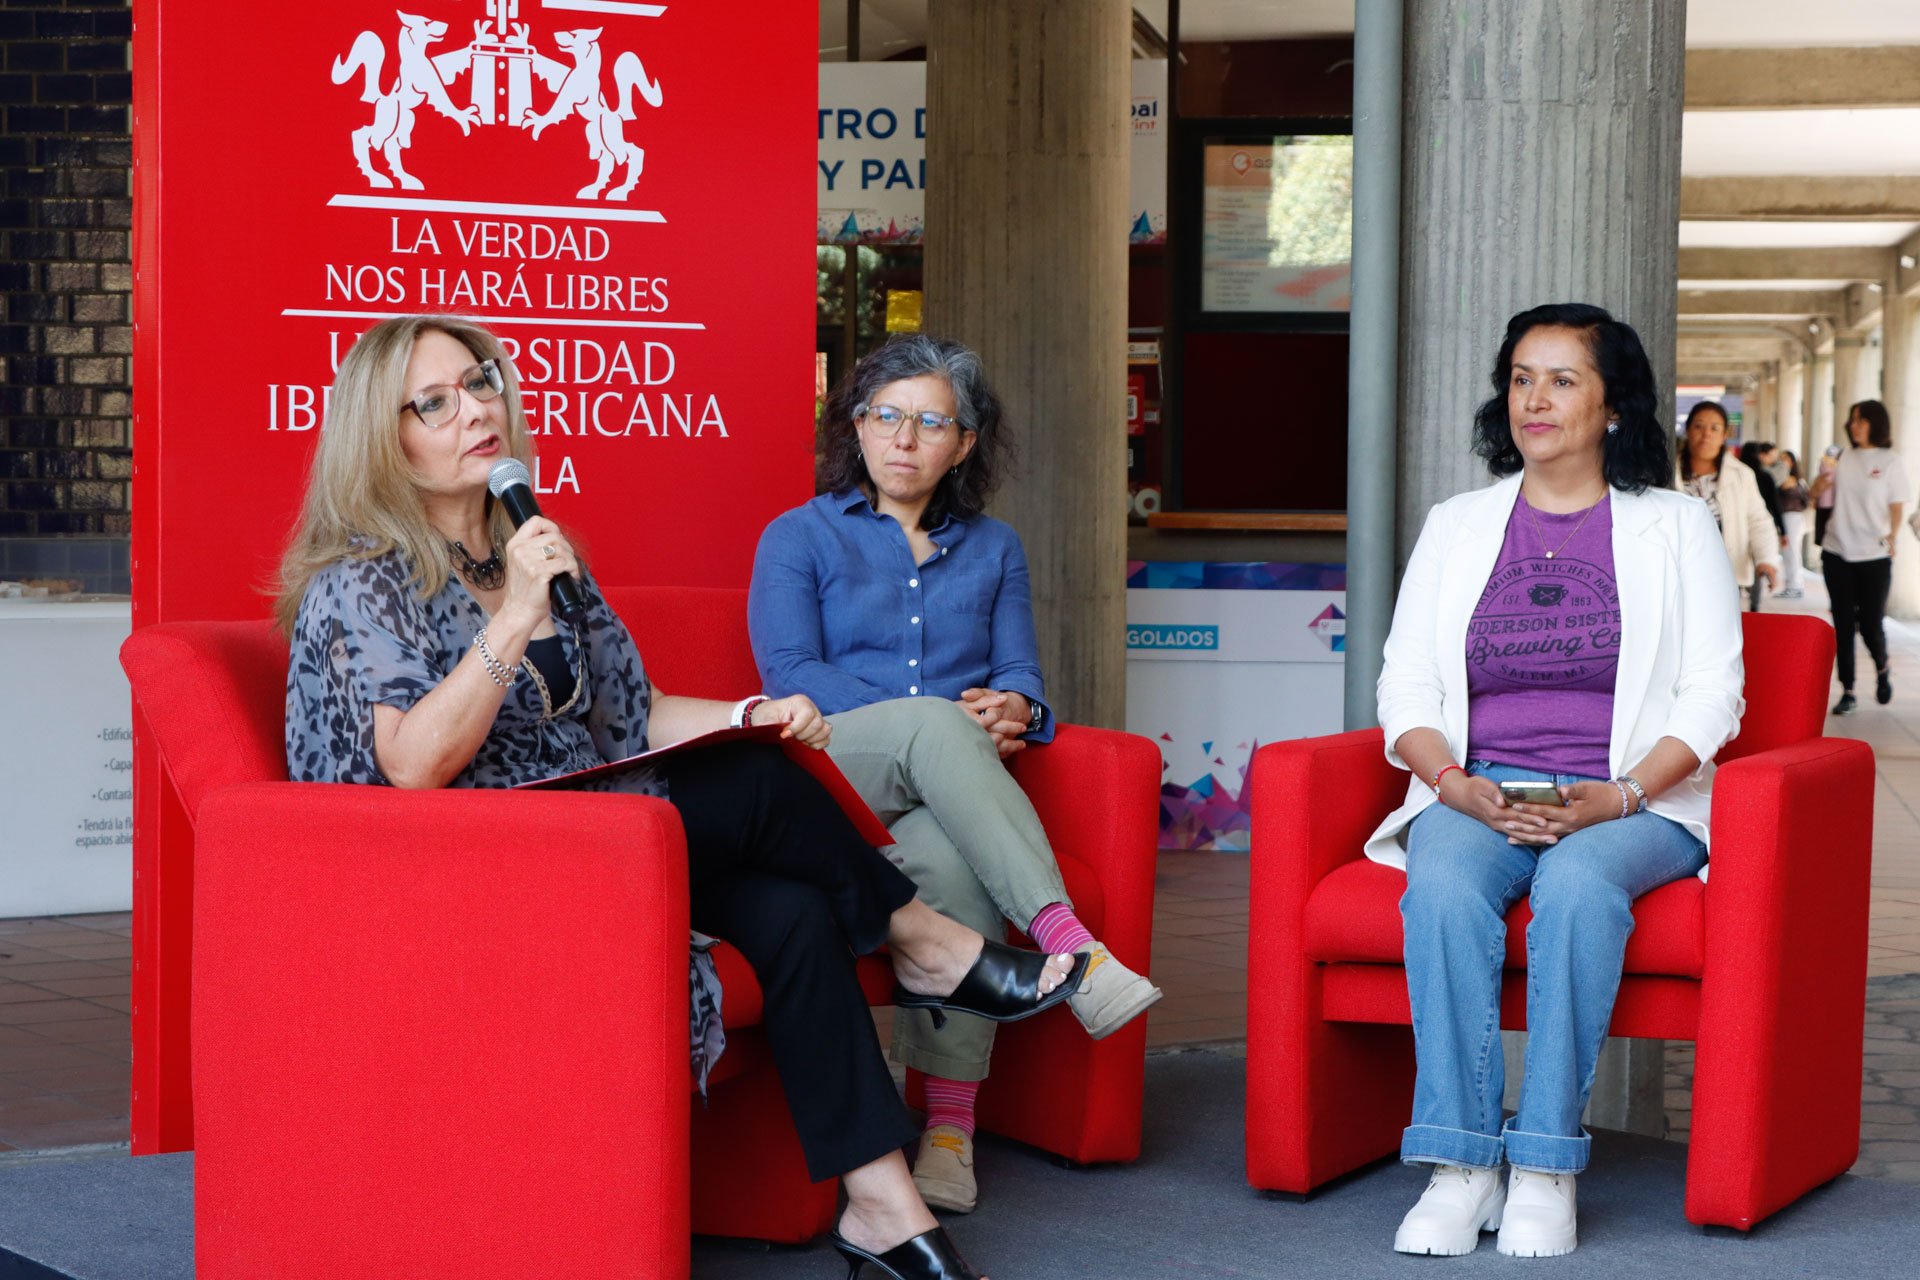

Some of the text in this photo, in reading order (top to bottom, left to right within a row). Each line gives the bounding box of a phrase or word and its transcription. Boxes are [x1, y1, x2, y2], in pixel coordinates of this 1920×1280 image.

[861, 158, 925, 189] PA
[390, 217, 610, 262] LA VERDAD
[325, 263, 669, 313] NOS HARÁ LIBRES
[1530, 563, 1594, 580] WITCHES
[1466, 634, 1585, 665] Brewing
